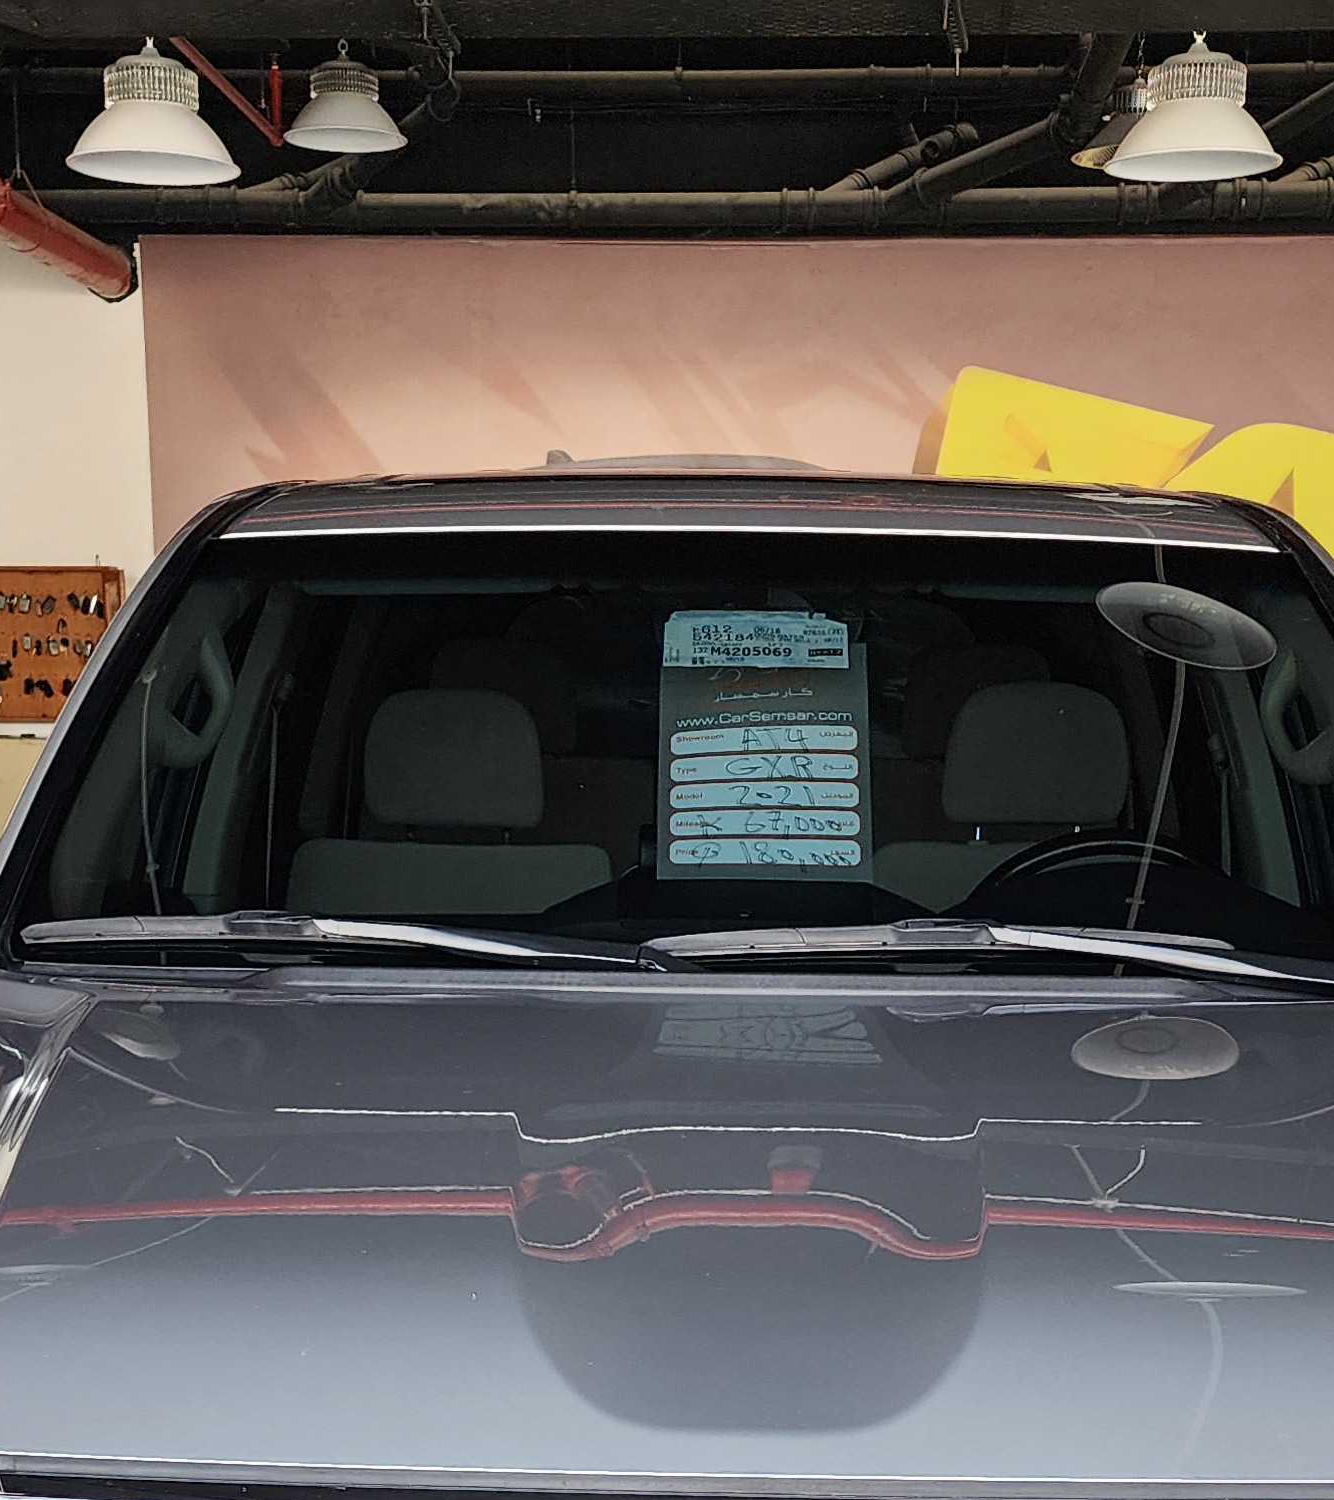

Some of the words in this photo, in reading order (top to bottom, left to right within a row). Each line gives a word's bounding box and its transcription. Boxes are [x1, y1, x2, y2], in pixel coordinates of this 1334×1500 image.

[711, 646, 792, 657] M4205069
[677, 711, 853, 728] www.CarSemsar.com
[676, 767, 697, 775] Type
[726, 755, 814, 778] GXR
